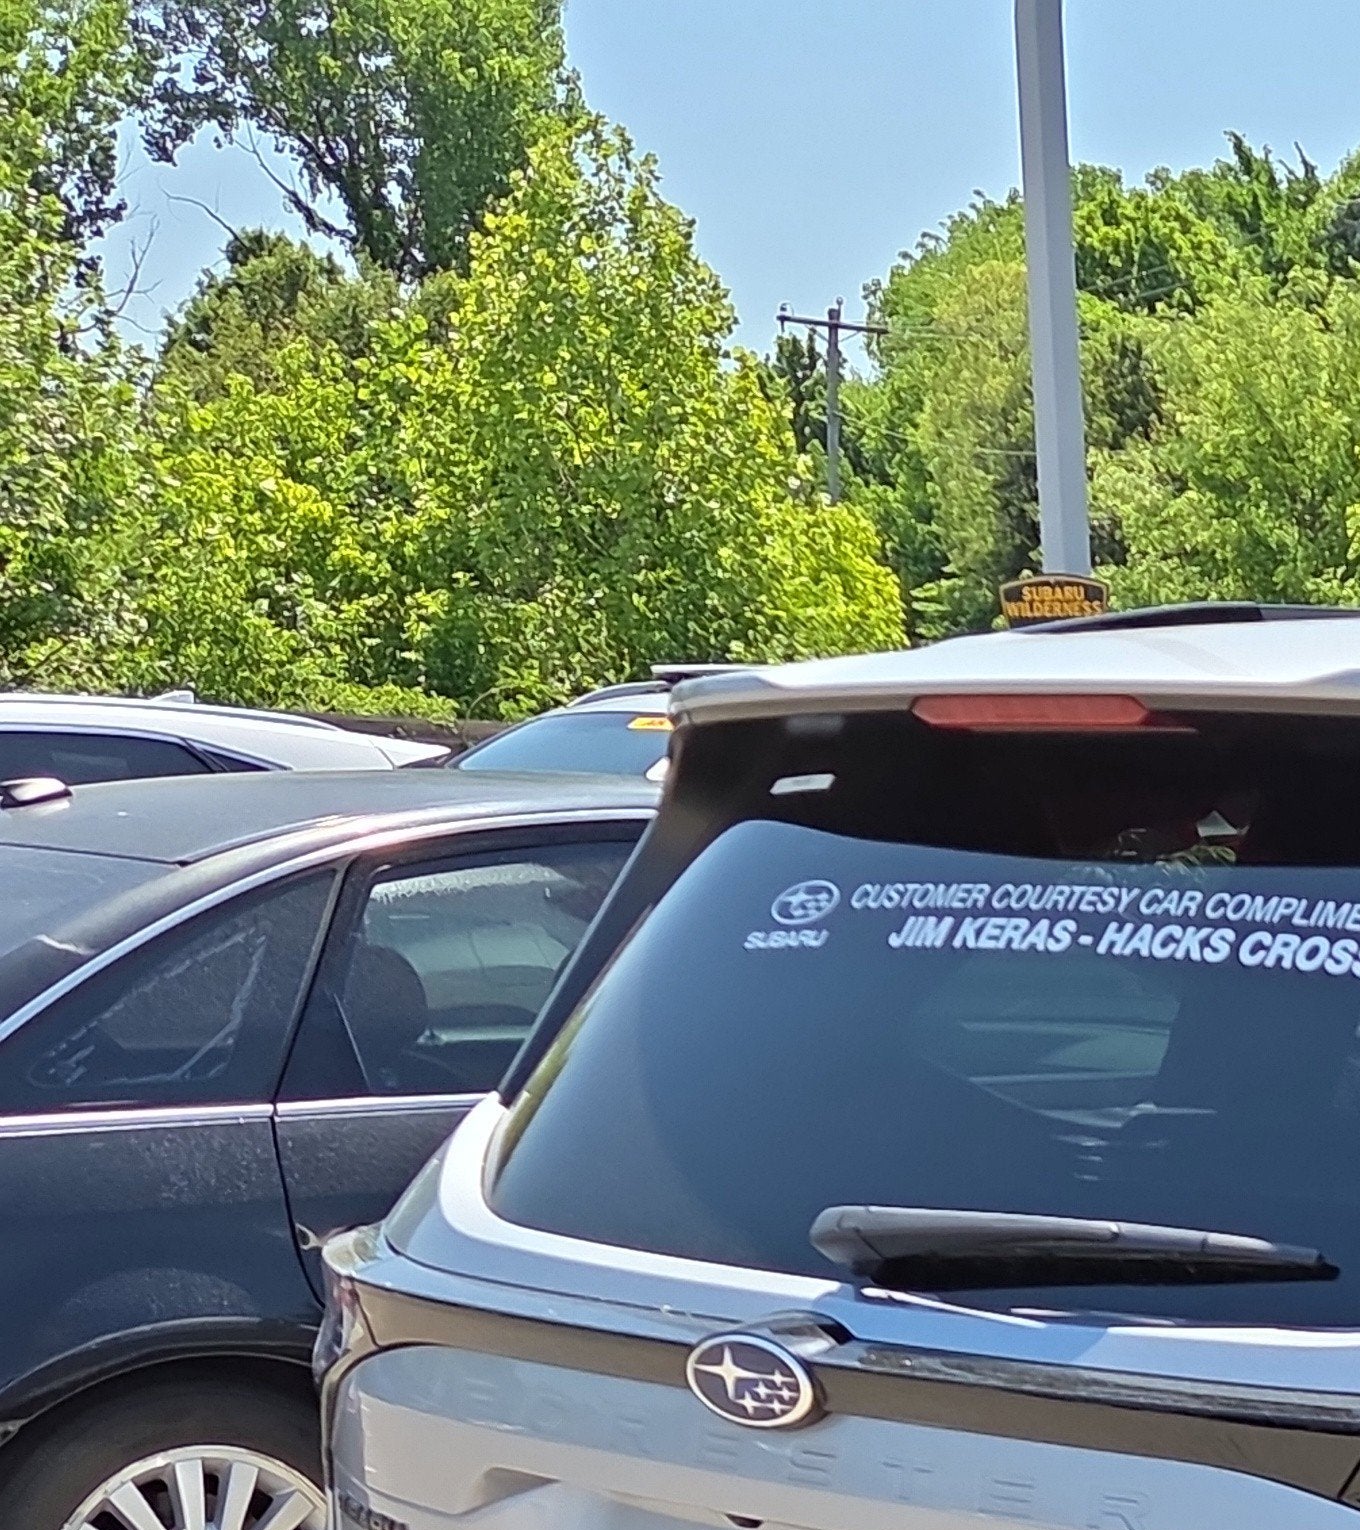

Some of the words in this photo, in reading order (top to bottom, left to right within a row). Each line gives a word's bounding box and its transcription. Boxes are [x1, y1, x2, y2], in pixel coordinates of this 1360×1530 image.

[1021, 585, 1085, 600] SUBARU
[1005, 600, 1103, 618] WILDERNESS
[850, 882, 992, 910] CUSTOMER
[991, 883, 1142, 914] COURTESY
[1140, 888, 1203, 917] CAR
[742, 928, 830, 950] SUBARU
[887, 915, 953, 948] JIM
[952, 916, 1078, 953] KERAS
[1095, 920, 1236, 964] HACKS
